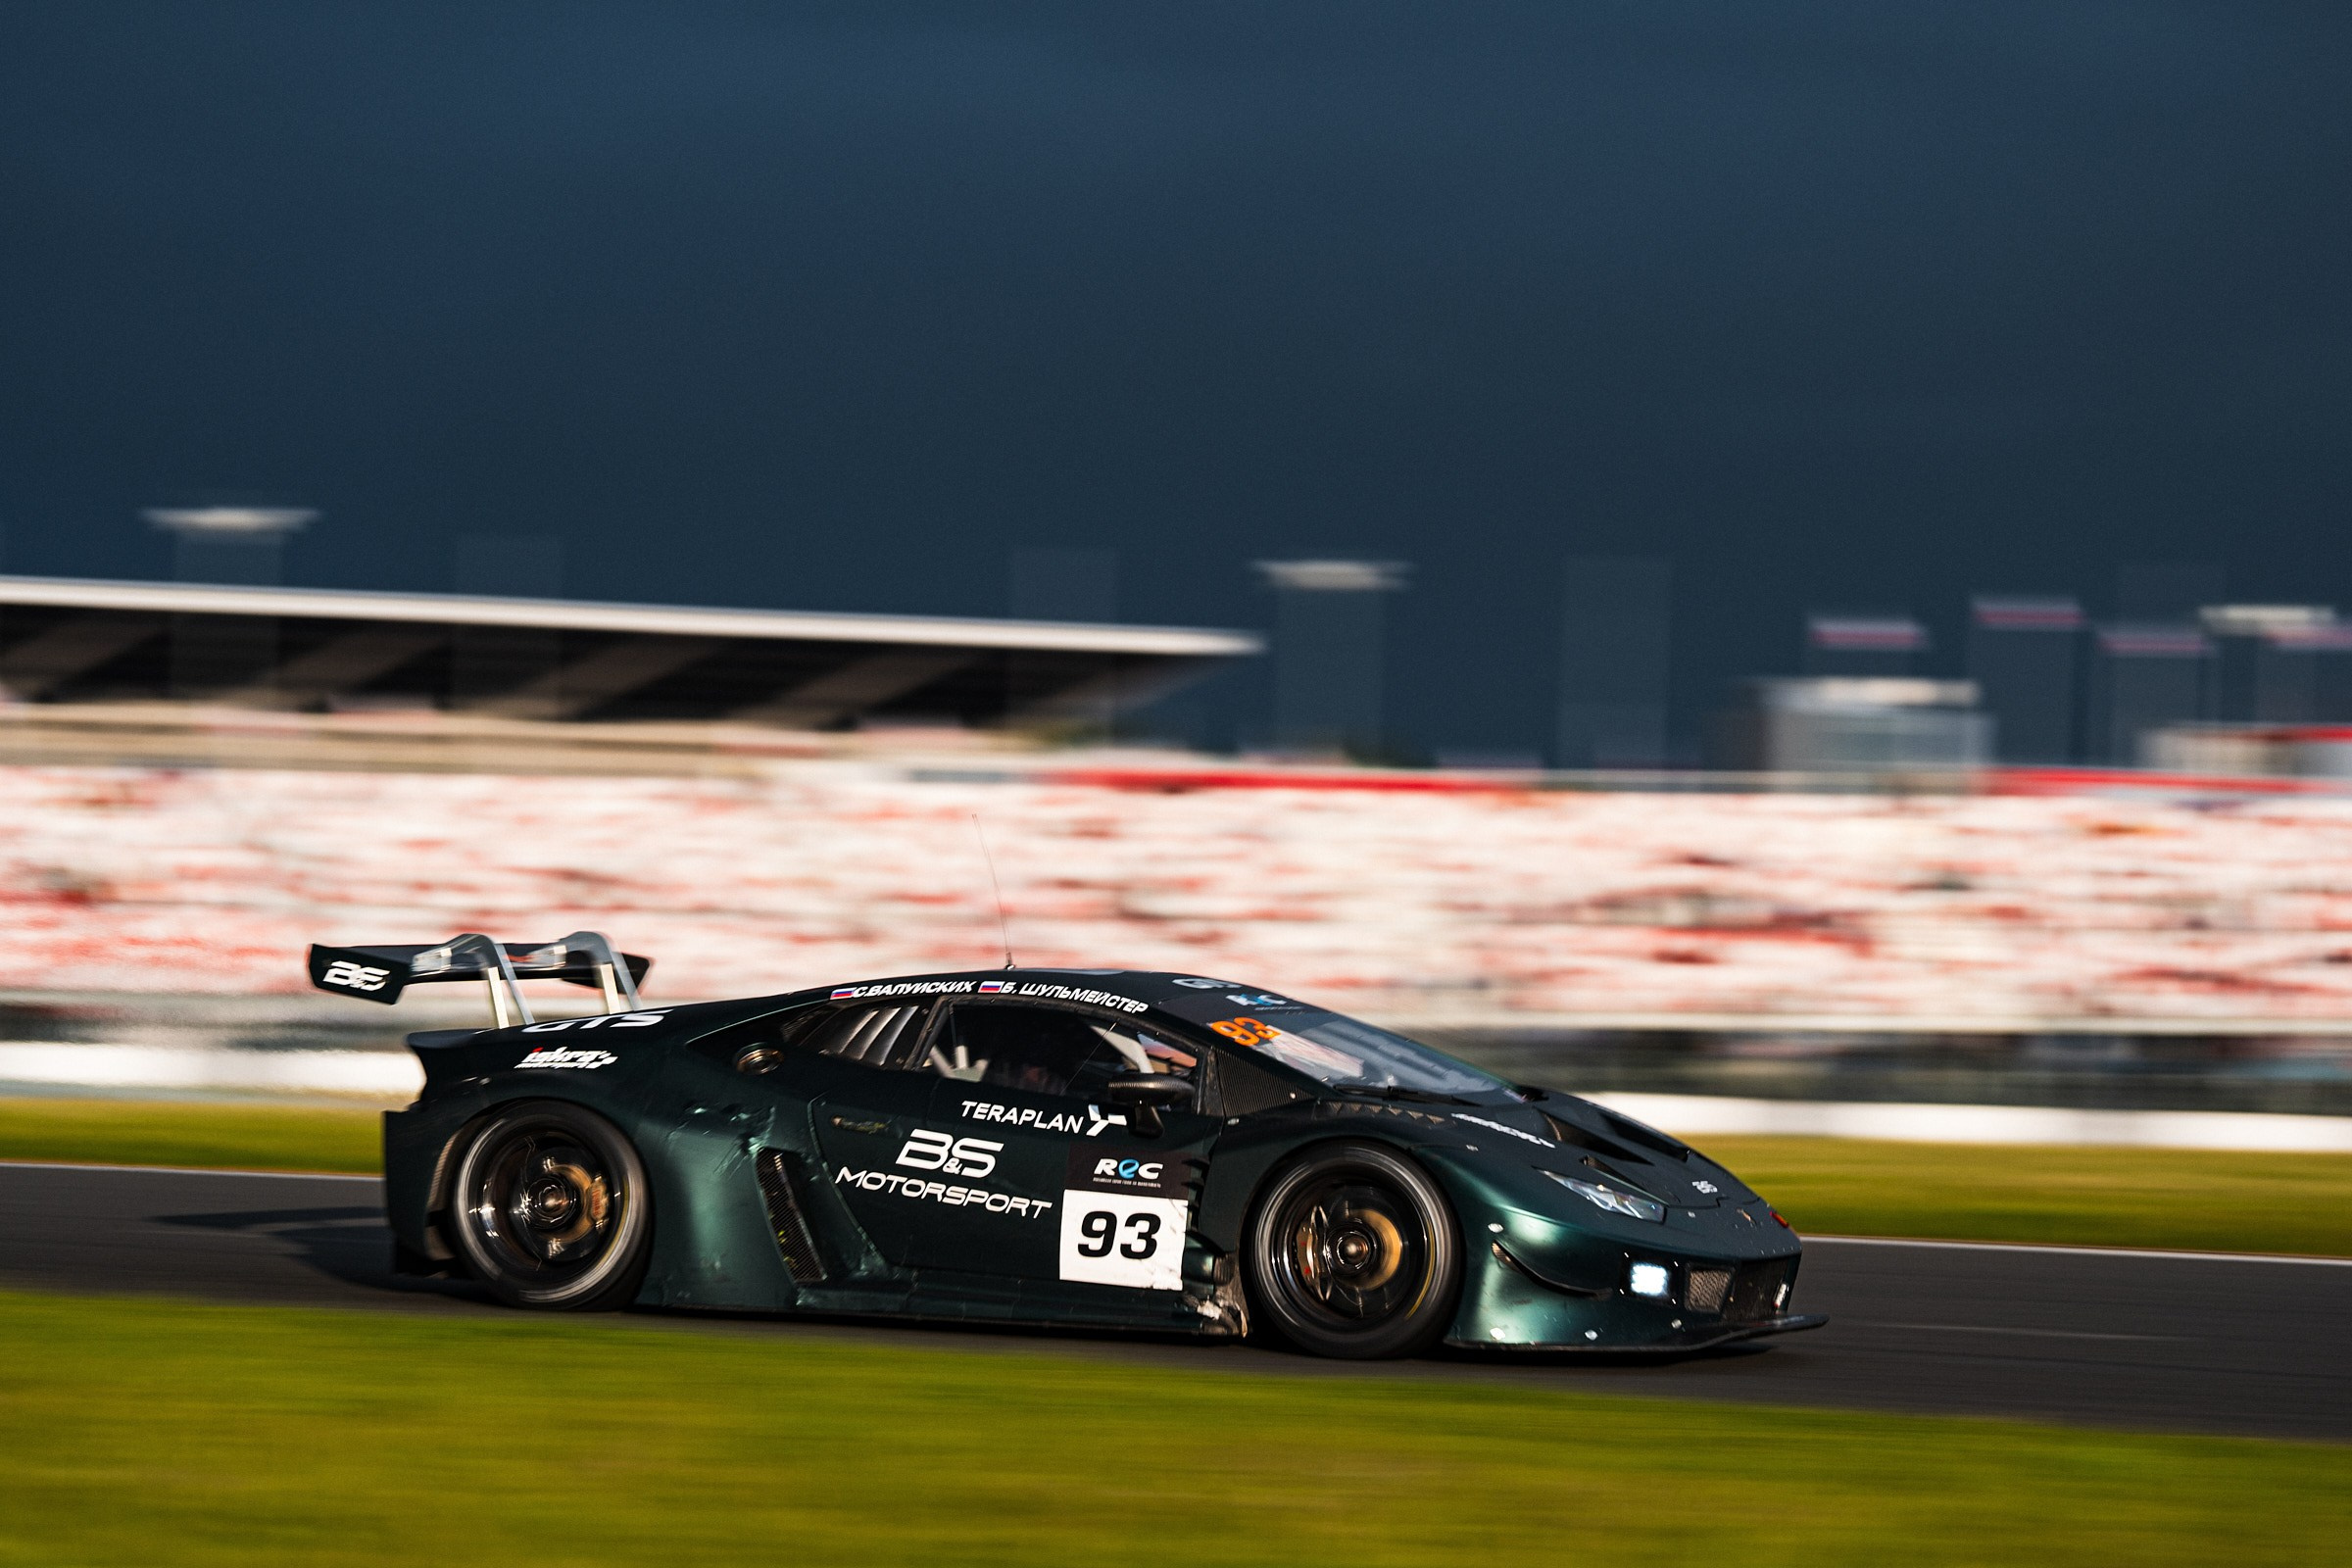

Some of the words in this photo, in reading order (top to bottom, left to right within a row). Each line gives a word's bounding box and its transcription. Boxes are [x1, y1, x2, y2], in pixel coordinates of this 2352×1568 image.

[961, 1101, 1084, 1134] TERAPLAN
[896, 1128, 1004, 1178] B&S
[835, 1166, 1053, 1219] MOTORSPORT
[1077, 1210, 1161, 1260] 93
